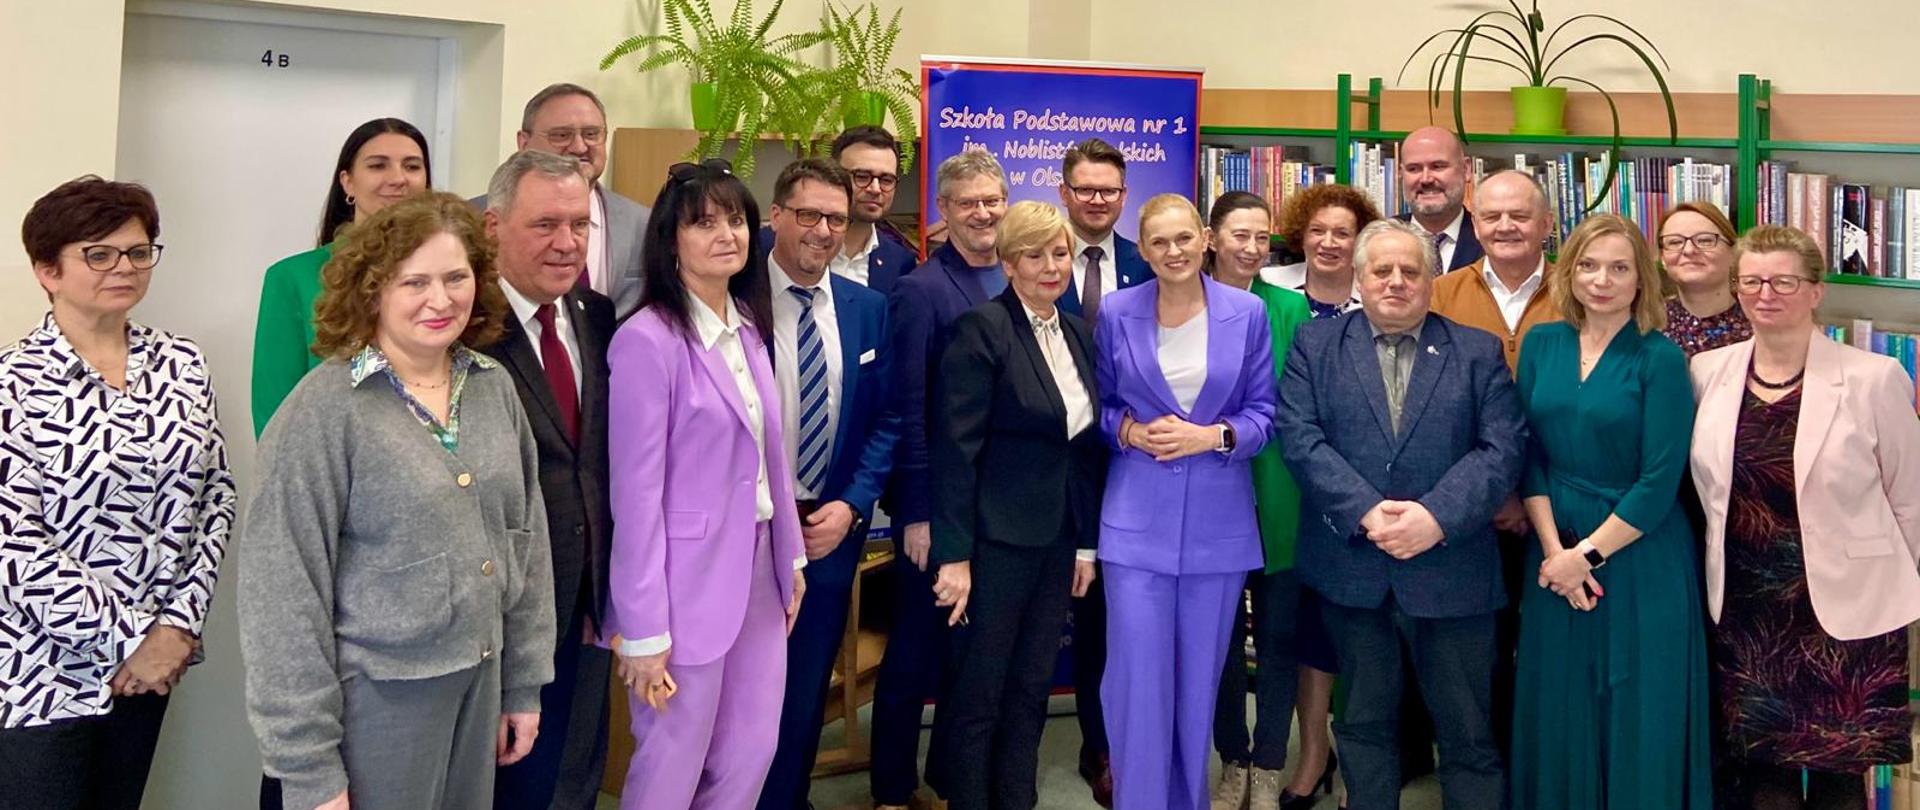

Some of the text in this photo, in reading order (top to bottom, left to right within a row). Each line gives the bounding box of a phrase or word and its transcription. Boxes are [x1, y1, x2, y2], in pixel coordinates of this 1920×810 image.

[940, 106, 1188, 134] Szkoła Podstawowa nr 1
[1004, 138, 1078, 159] Noblist
[1117, 141, 1166, 162] lskich
[1010, 166, 1064, 187] w Ols
